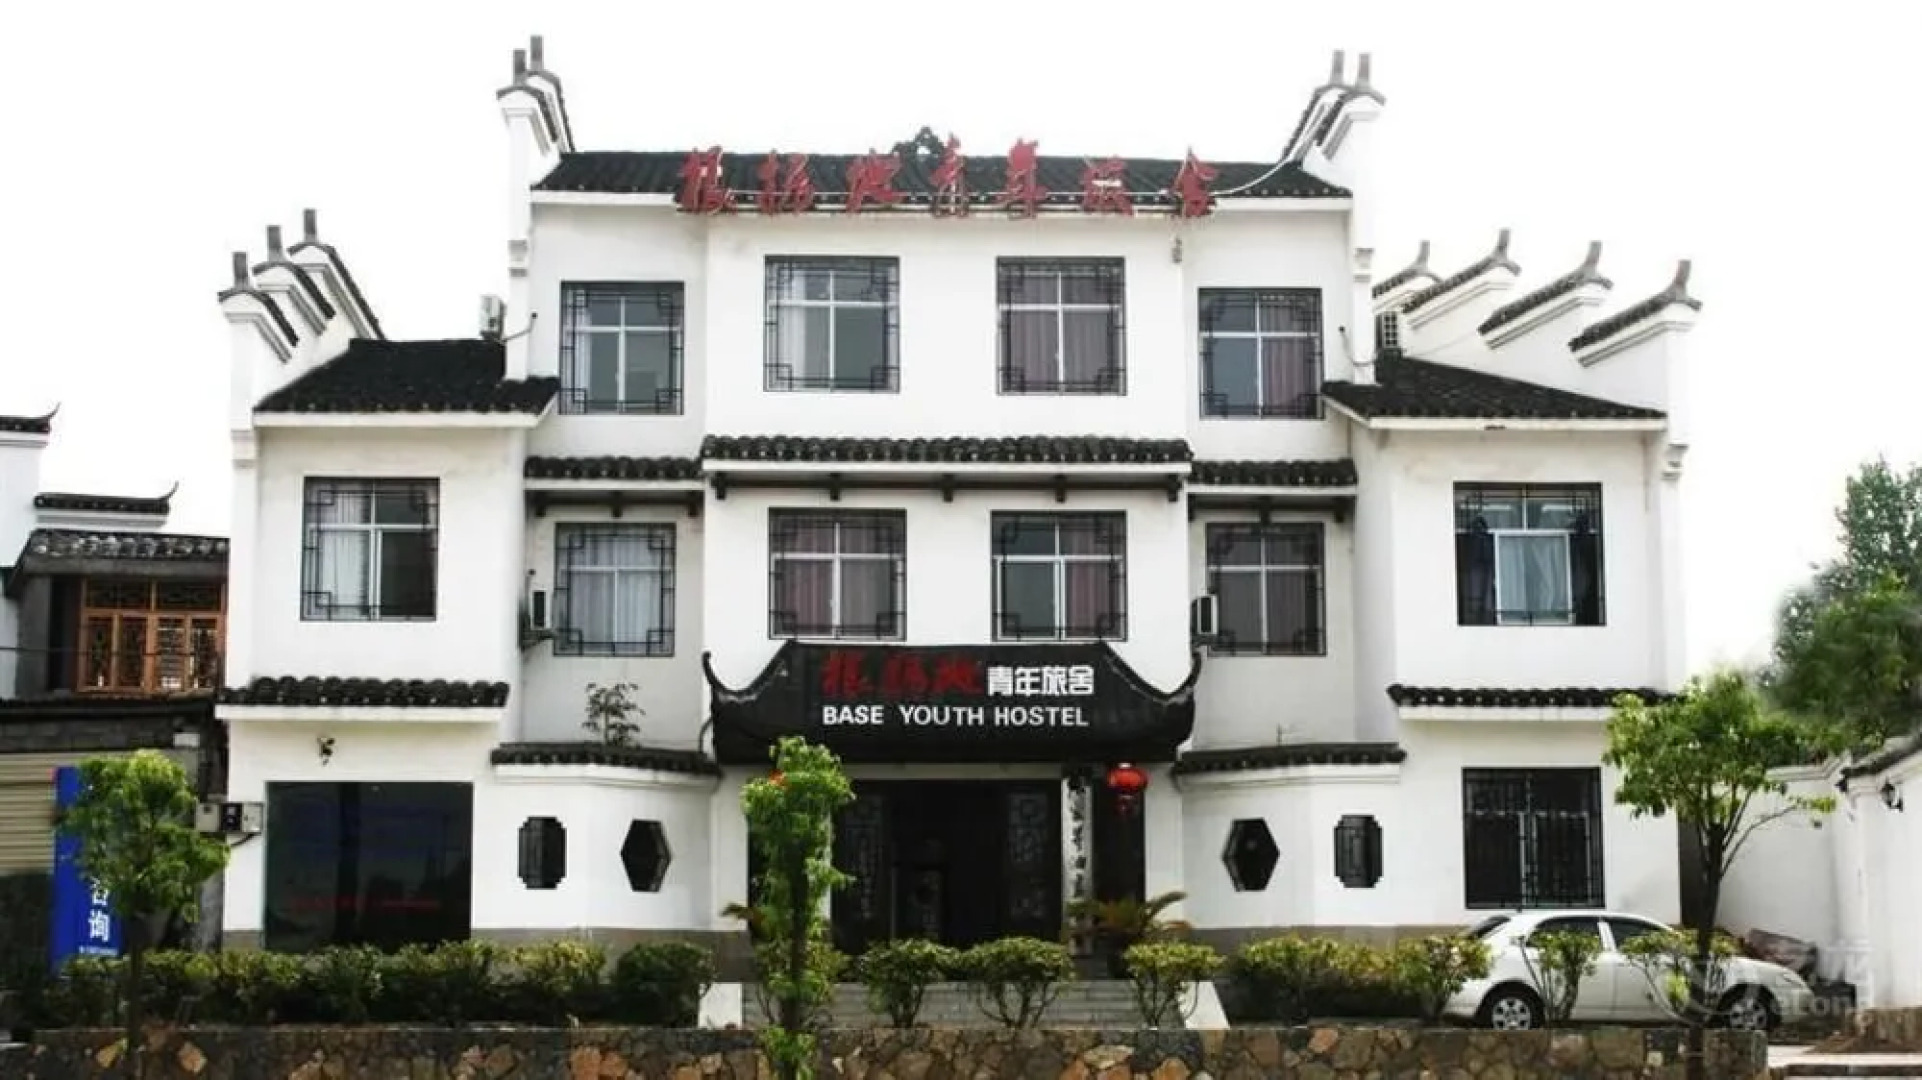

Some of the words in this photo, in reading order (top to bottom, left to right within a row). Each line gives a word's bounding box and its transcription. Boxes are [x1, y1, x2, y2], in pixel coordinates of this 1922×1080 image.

[822, 704, 884, 726] BASE
[900, 705, 984, 727] YOUTH
[995, 706, 1090, 728] HOSTEL
